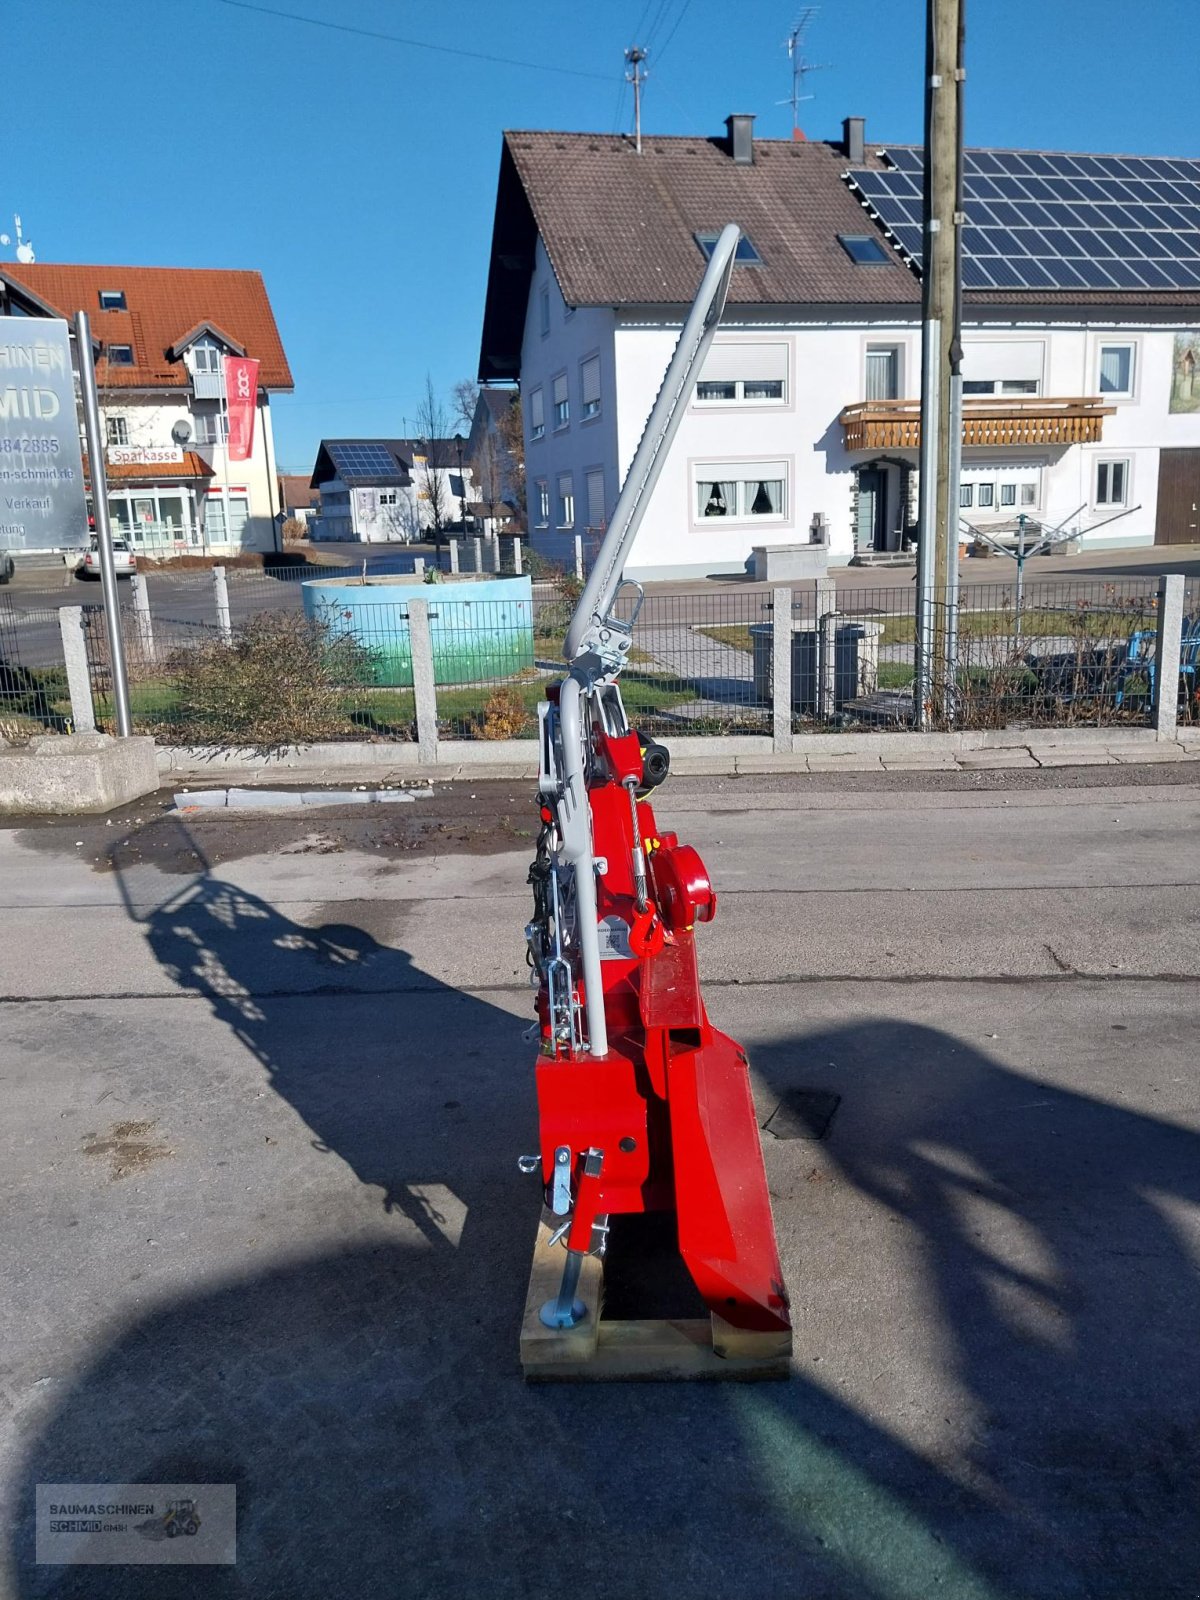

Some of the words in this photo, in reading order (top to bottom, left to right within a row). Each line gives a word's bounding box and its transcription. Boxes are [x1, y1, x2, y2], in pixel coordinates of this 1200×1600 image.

[0, 439, 59, 453] 842885
[114, 449, 177, 464] Sparkasse
[5, 498, 51, 510] Verkauf
